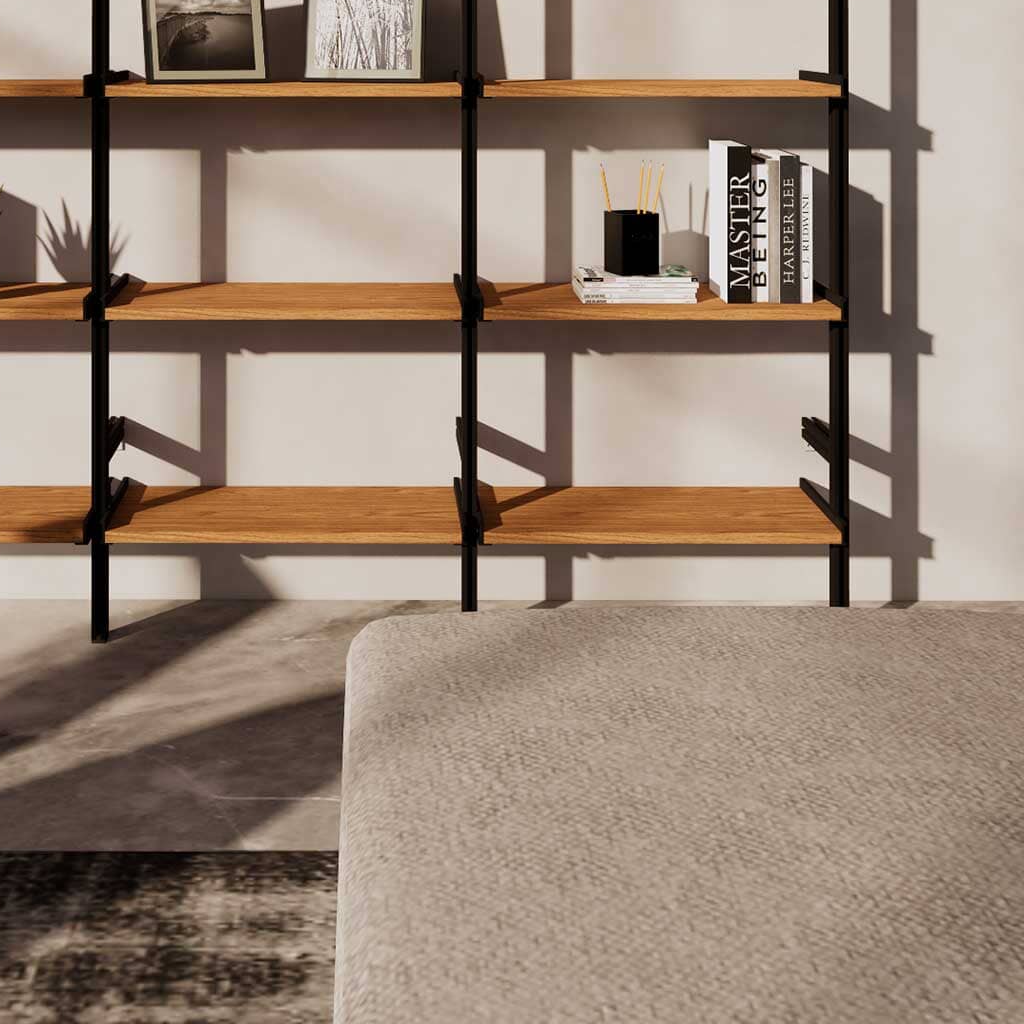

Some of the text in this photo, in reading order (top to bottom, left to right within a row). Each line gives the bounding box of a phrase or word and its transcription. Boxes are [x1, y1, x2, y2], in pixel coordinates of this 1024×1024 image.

[729, 172, 750, 289] MASTER
[753, 179, 766, 286] BEING
[784, 178, 794, 283] HARPER LEE
